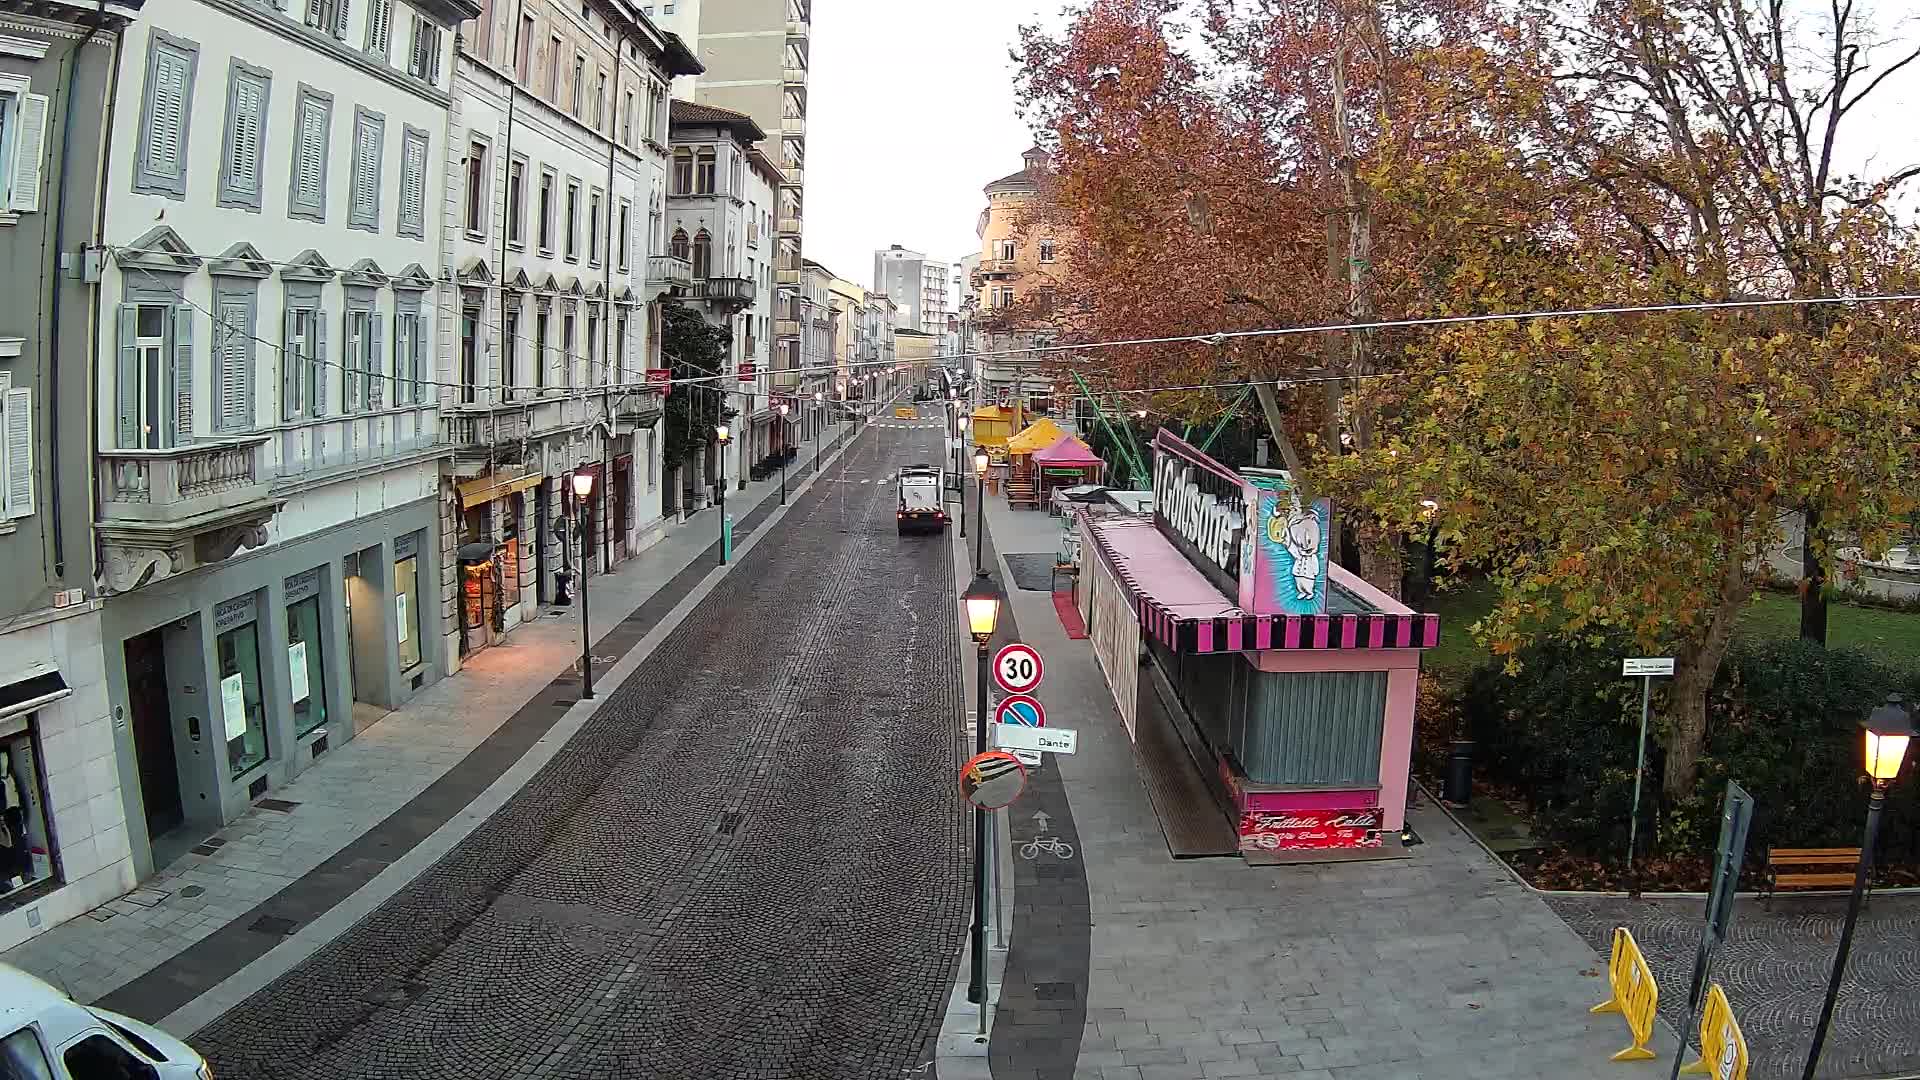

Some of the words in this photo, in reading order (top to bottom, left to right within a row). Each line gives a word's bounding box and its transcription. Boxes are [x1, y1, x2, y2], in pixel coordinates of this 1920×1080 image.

[1162, 458, 1233, 570] Golosone
[1005, 657, 1033, 680] 30
[1038, 737, 1070, 749] Dante
[1325, 815, 1377, 828] Calde
